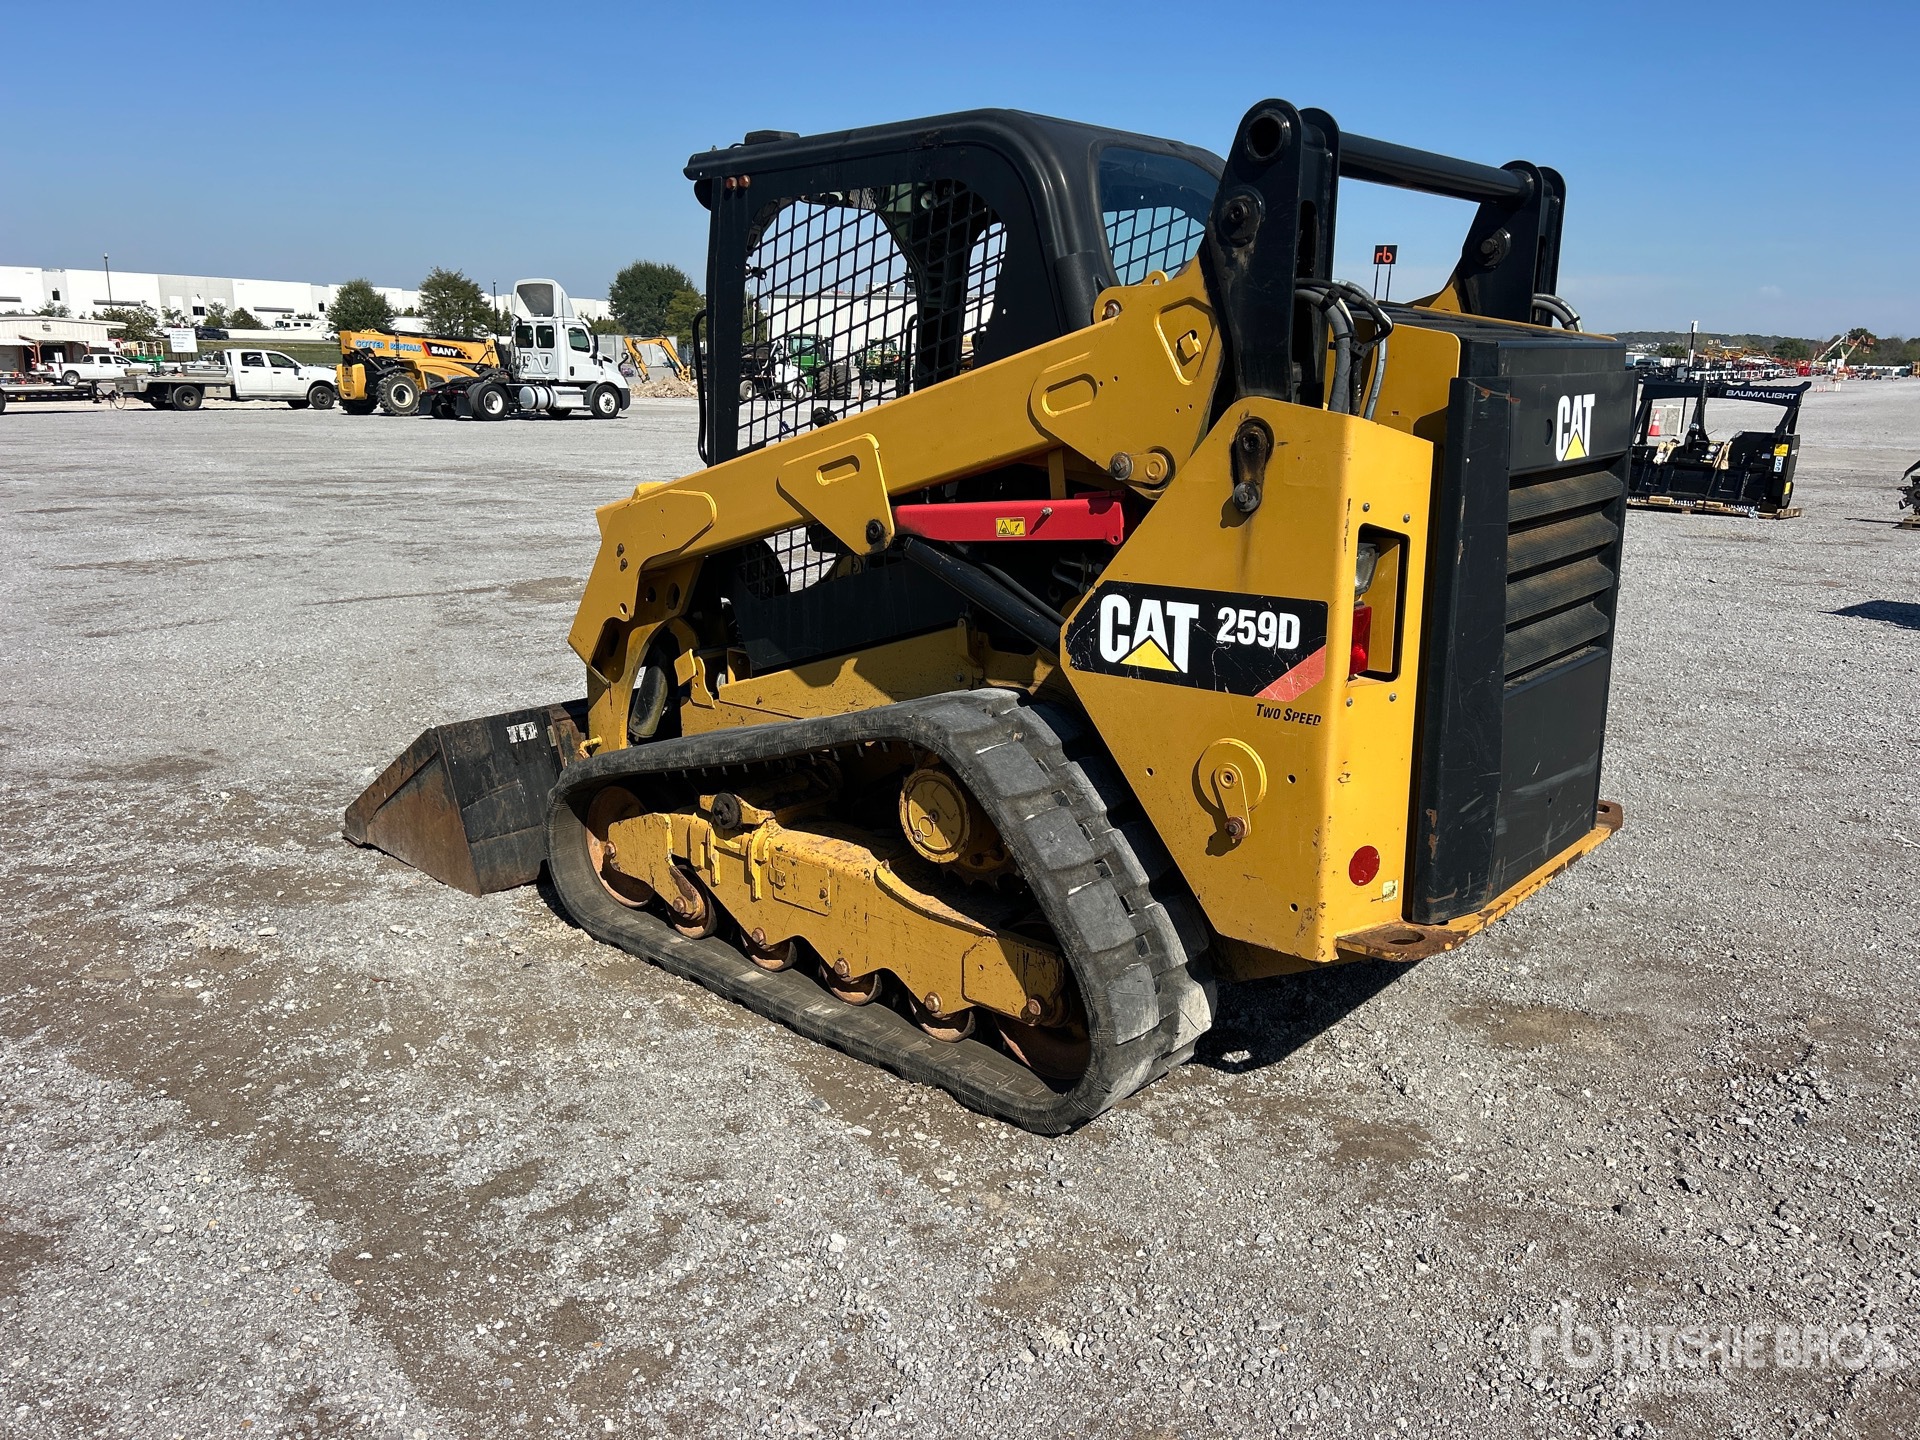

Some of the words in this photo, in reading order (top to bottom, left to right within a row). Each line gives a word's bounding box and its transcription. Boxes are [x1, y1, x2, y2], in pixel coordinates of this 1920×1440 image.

[1375, 246, 1393, 263] rb
[431, 346, 457, 356] SANY
[1726, 390, 1797, 399] BAUMALIGHT
[1555, 393, 1595, 462] CAT
[1100, 593, 1199, 674] CAT
[1216, 607, 1301, 650] 259D
